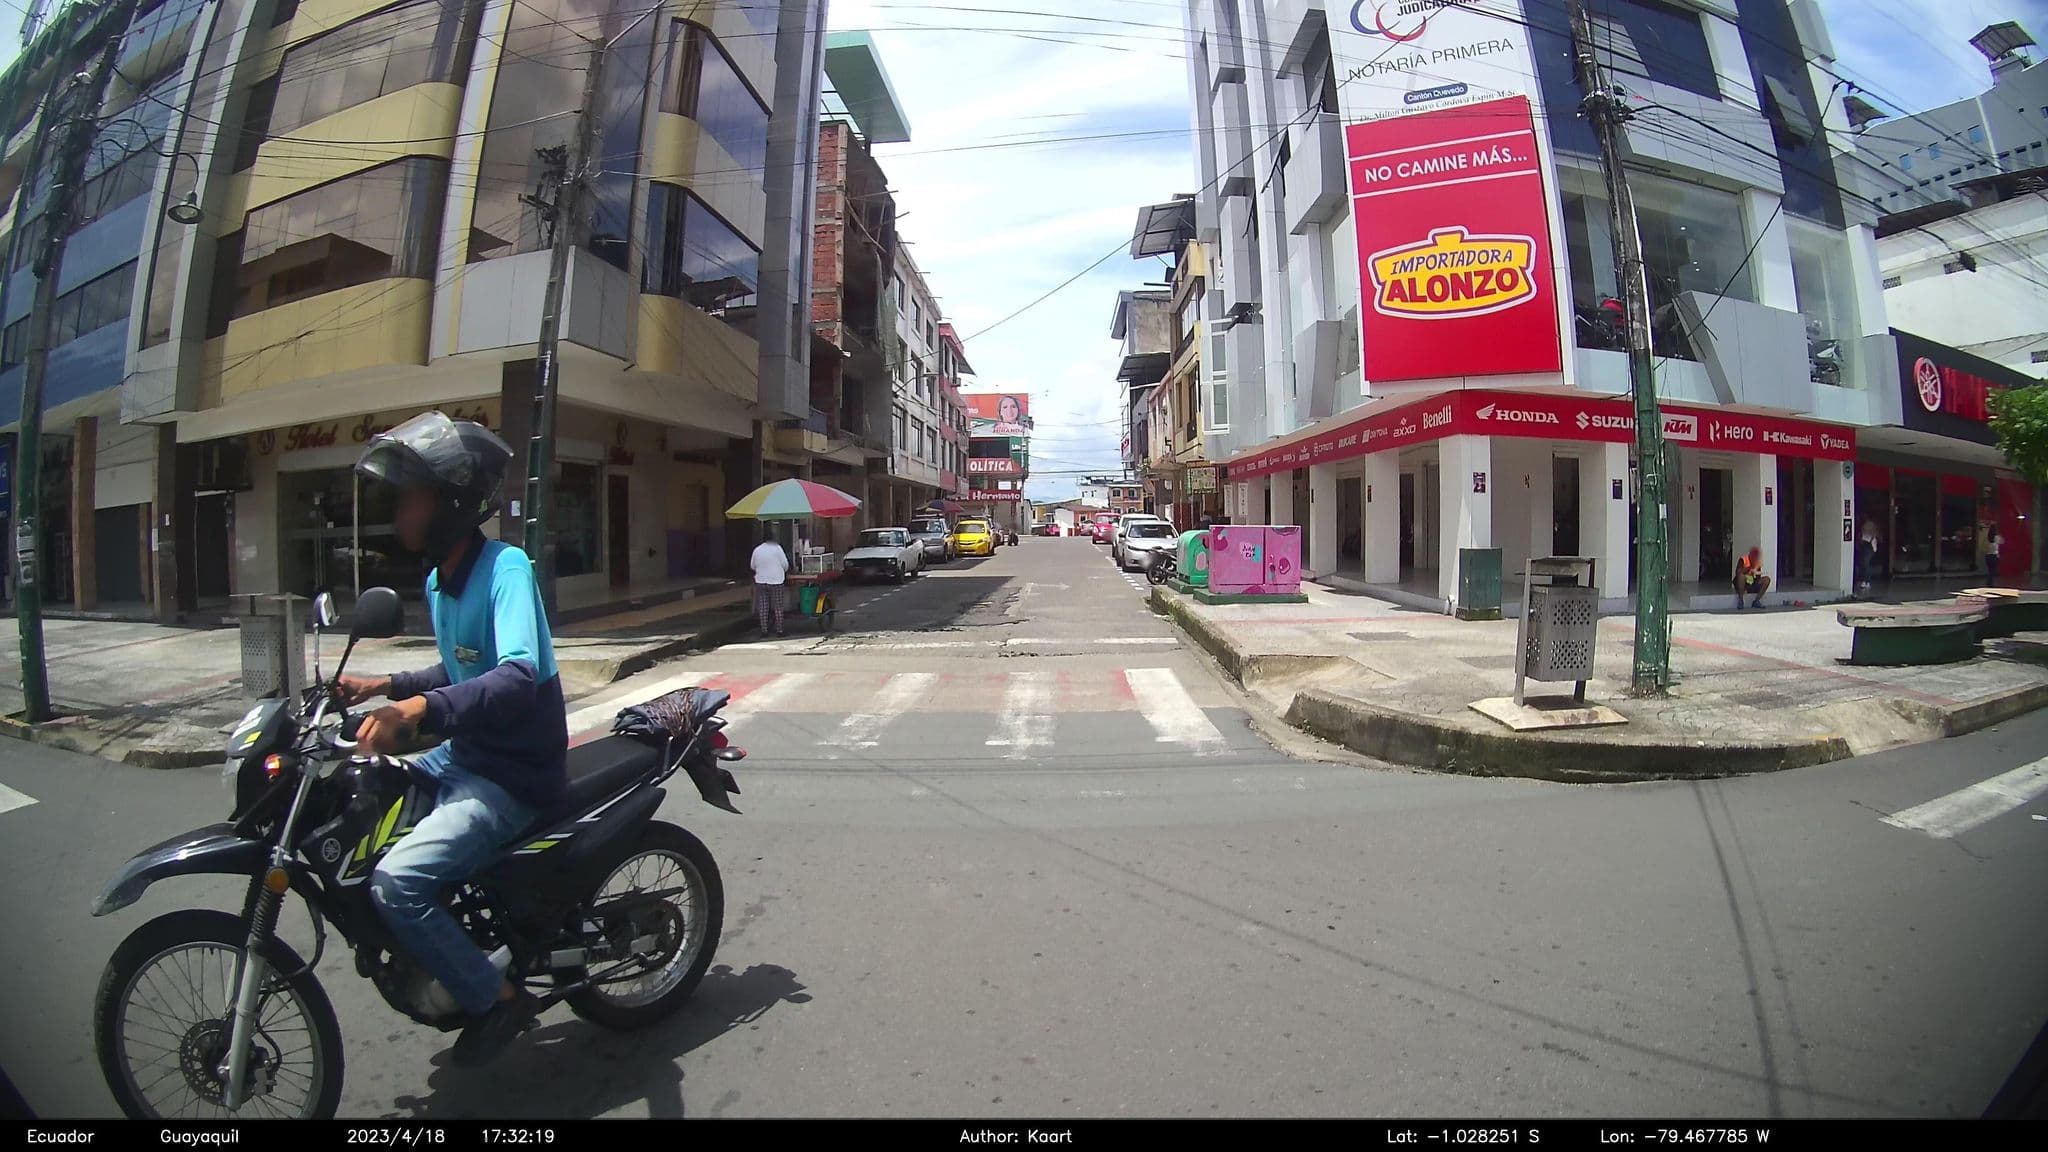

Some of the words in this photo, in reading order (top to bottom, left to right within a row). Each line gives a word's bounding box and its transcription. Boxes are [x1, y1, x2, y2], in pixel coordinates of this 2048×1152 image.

[1349, 52, 1427, 81] NOTARÍA
[1432, 38, 1514, 64] PRIMERA
[1407, 91, 1432, 102] Cantón
[1433, 86, 1465, 98] Quevedo
[1365, 166, 1392, 183] NO
[1397, 153, 1467, 178] CAMINE
[1473, 145, 1528, 167] MÁS...
[1390, 248, 1513, 276] IMPORTADORA
[1385, 267, 1519, 303] ALONZO
[1422, 404, 1452, 430] Benelli
[1496, 409, 1560, 425] HONDA
[1591, 415, 1636, 429] SUZU
[1663, 419, 1692, 435] KTM
[284, 423, 339, 451] Hotel
[1779, 432, 1812, 446] Kawasaki
[972, 490, 1021, 501] Hermano
